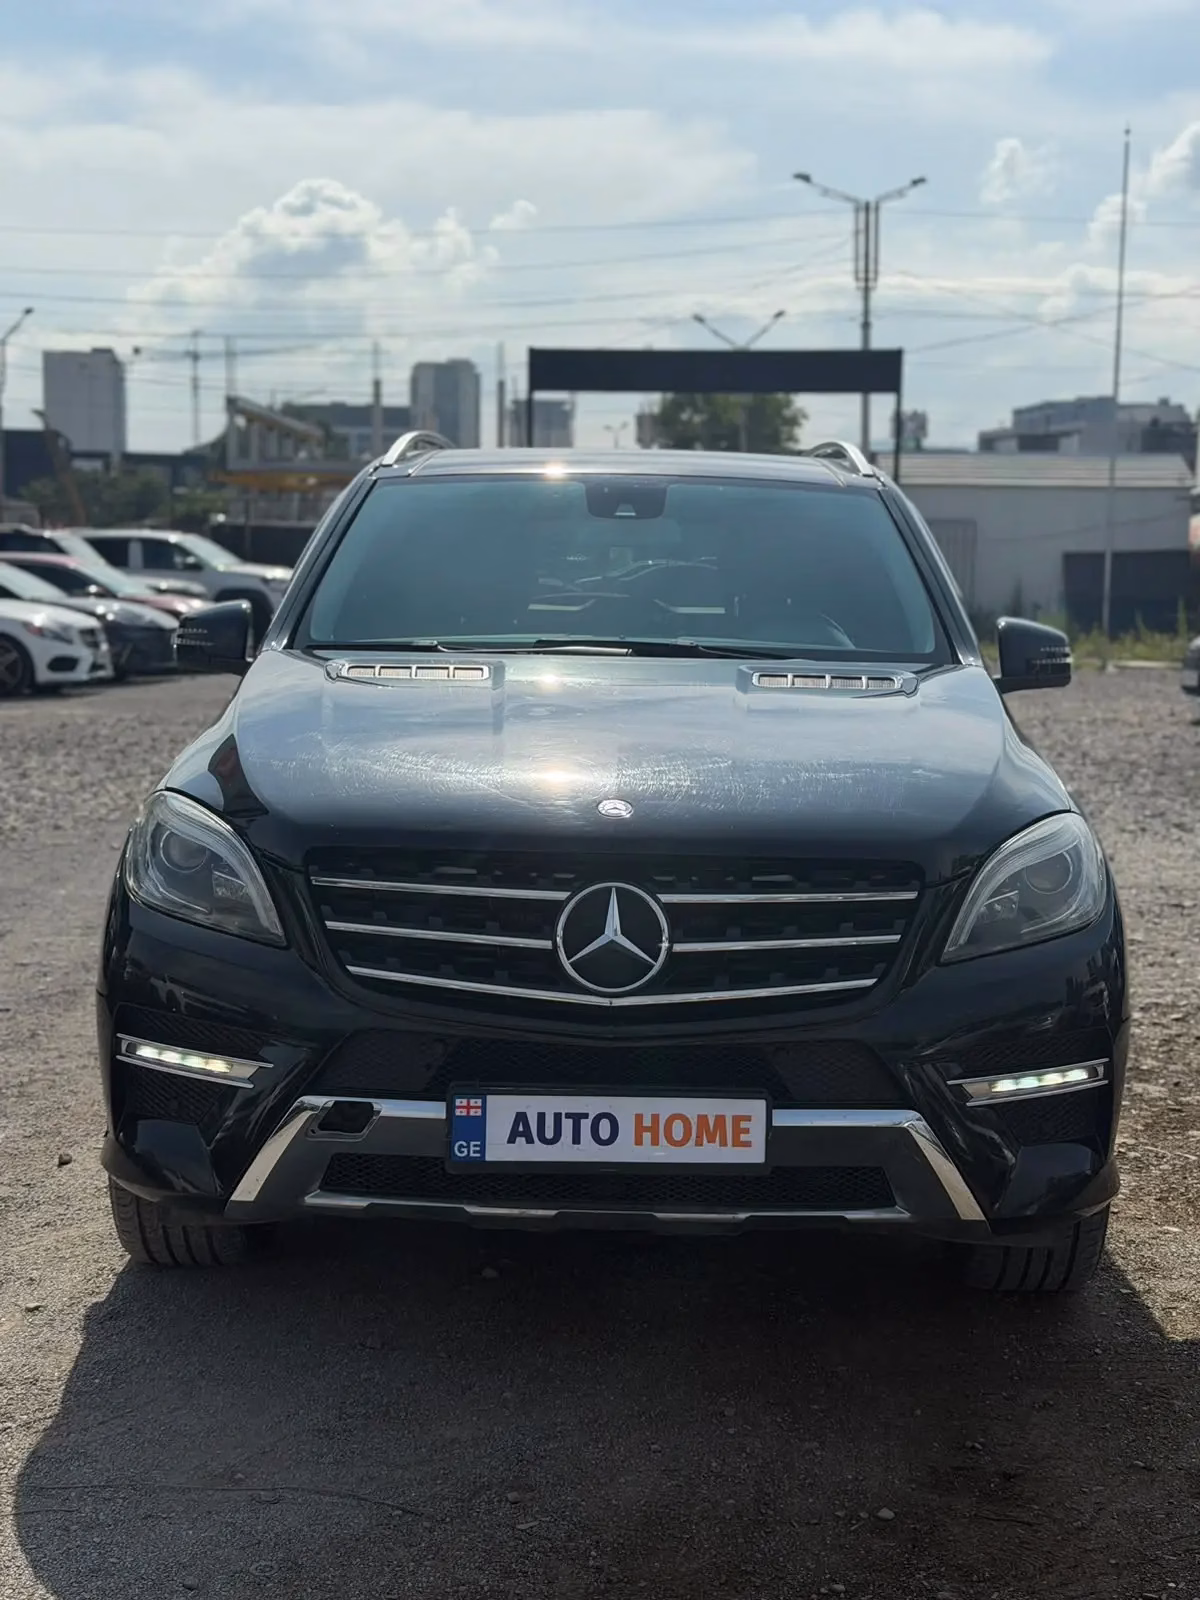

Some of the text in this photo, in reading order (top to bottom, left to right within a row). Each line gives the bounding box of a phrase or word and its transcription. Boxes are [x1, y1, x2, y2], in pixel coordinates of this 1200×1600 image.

[507, 1111, 752, 1148] AUTO HOME
[454, 1141, 481, 1157] GE
